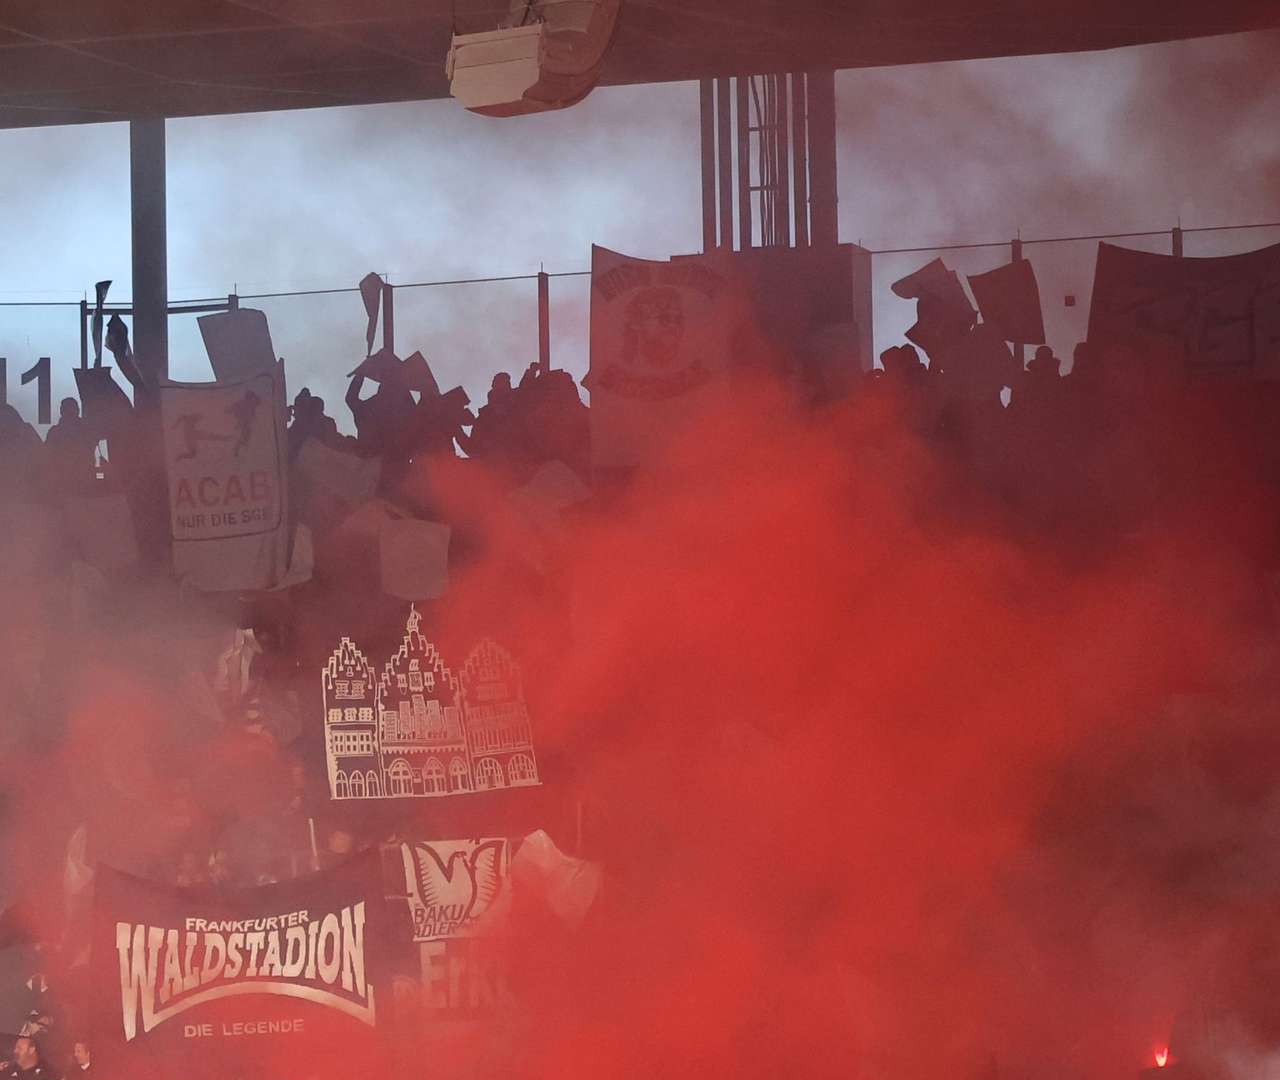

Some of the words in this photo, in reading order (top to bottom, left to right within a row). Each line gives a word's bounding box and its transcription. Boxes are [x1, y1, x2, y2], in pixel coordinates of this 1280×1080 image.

[175, 470, 270, 508] ACAB
[211, 511, 238, 527] DIE
[186, 909, 310, 933] FRANKFURTER
[415, 904, 465, 925] BAKU
[116, 901, 367, 1042] WALDSTADION
[184, 1023, 214, 1038] DIE
[223, 1018, 305, 1036] LEGENDE
